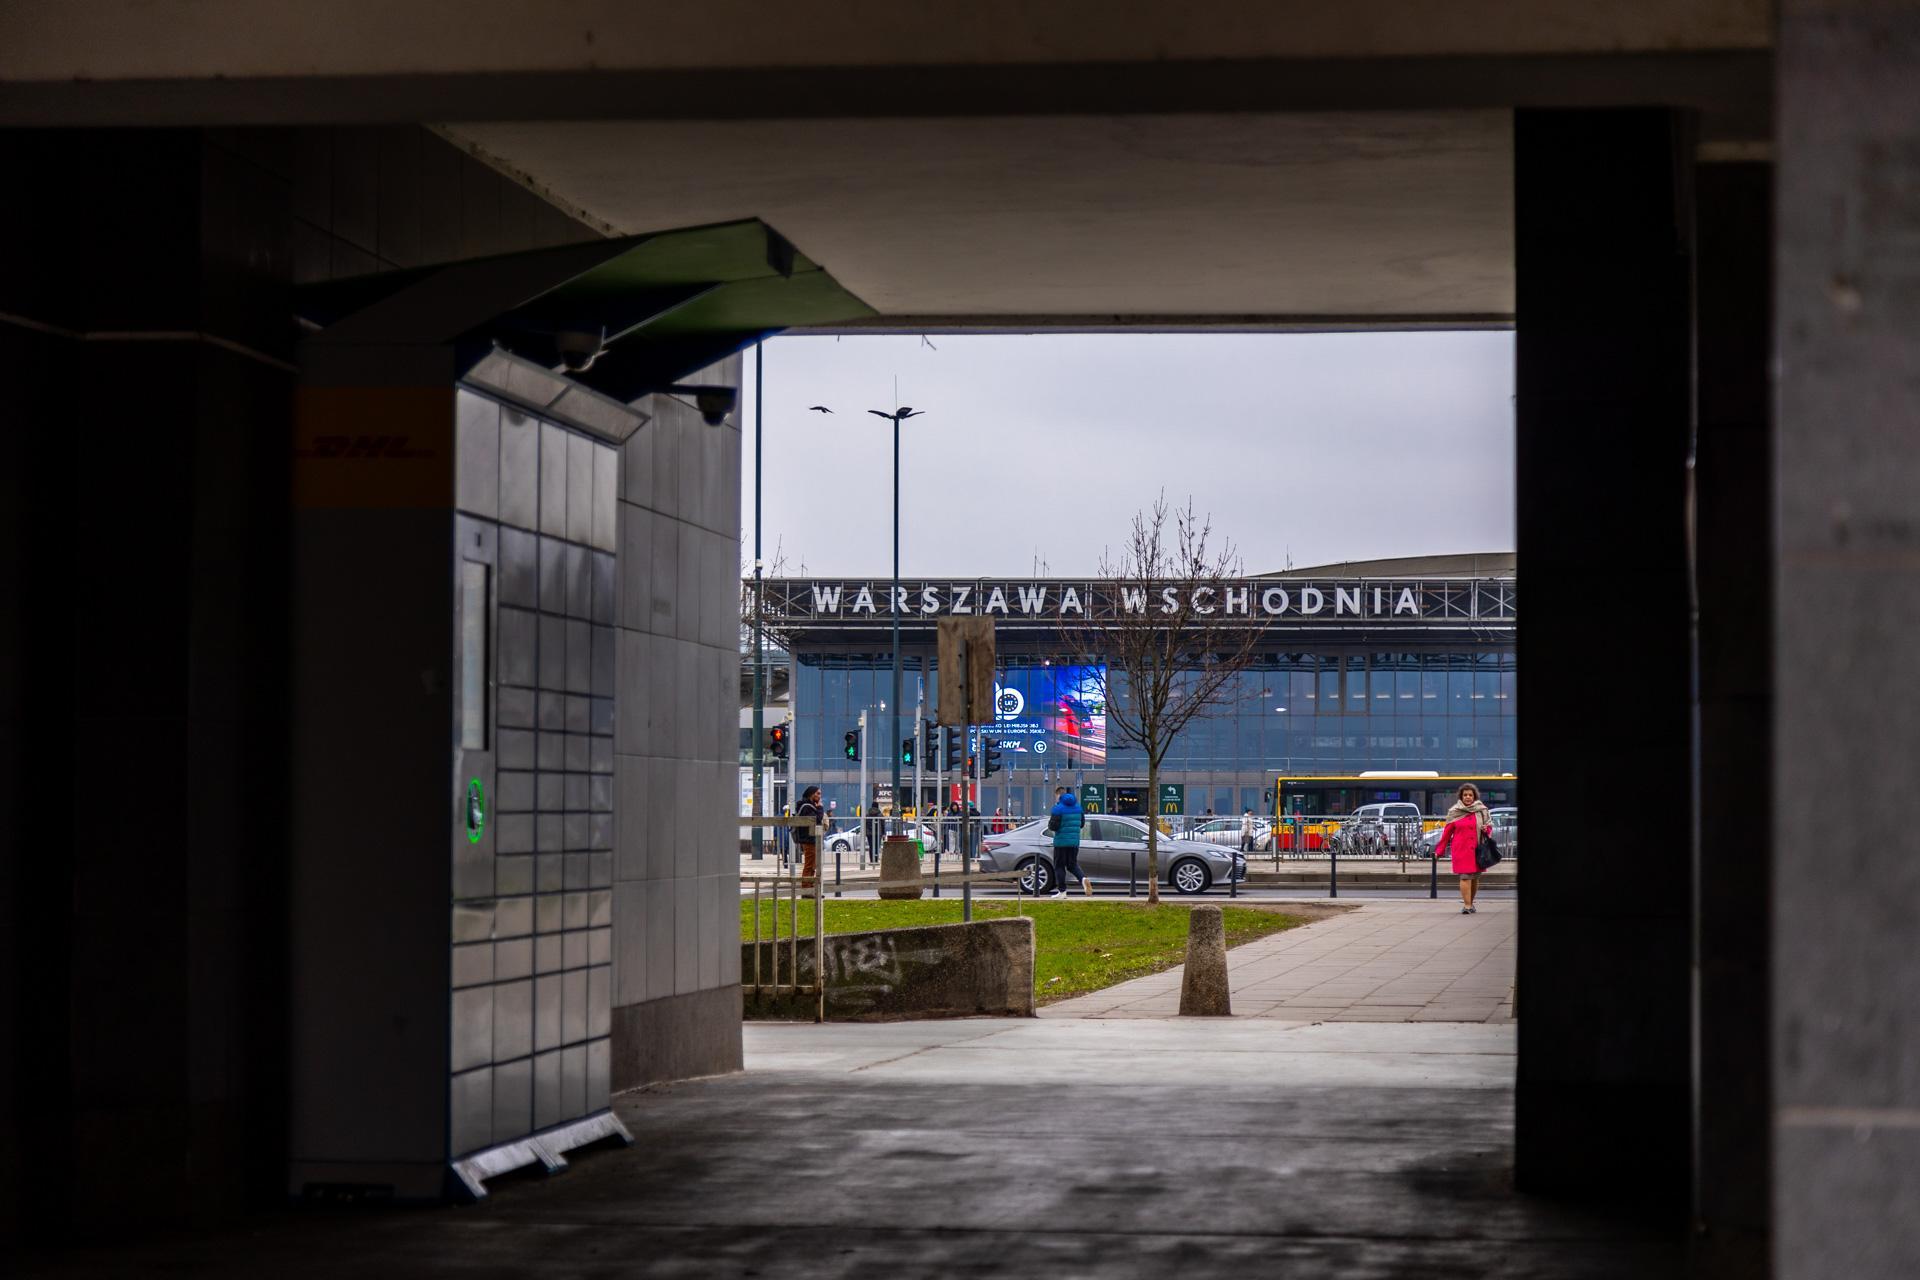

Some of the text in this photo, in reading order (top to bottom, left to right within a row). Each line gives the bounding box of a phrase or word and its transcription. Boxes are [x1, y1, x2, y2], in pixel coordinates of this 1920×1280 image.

[311, 436, 416, 458] DHL
[812, 586, 1419, 615] WARSZAWA WSCHODNIA
